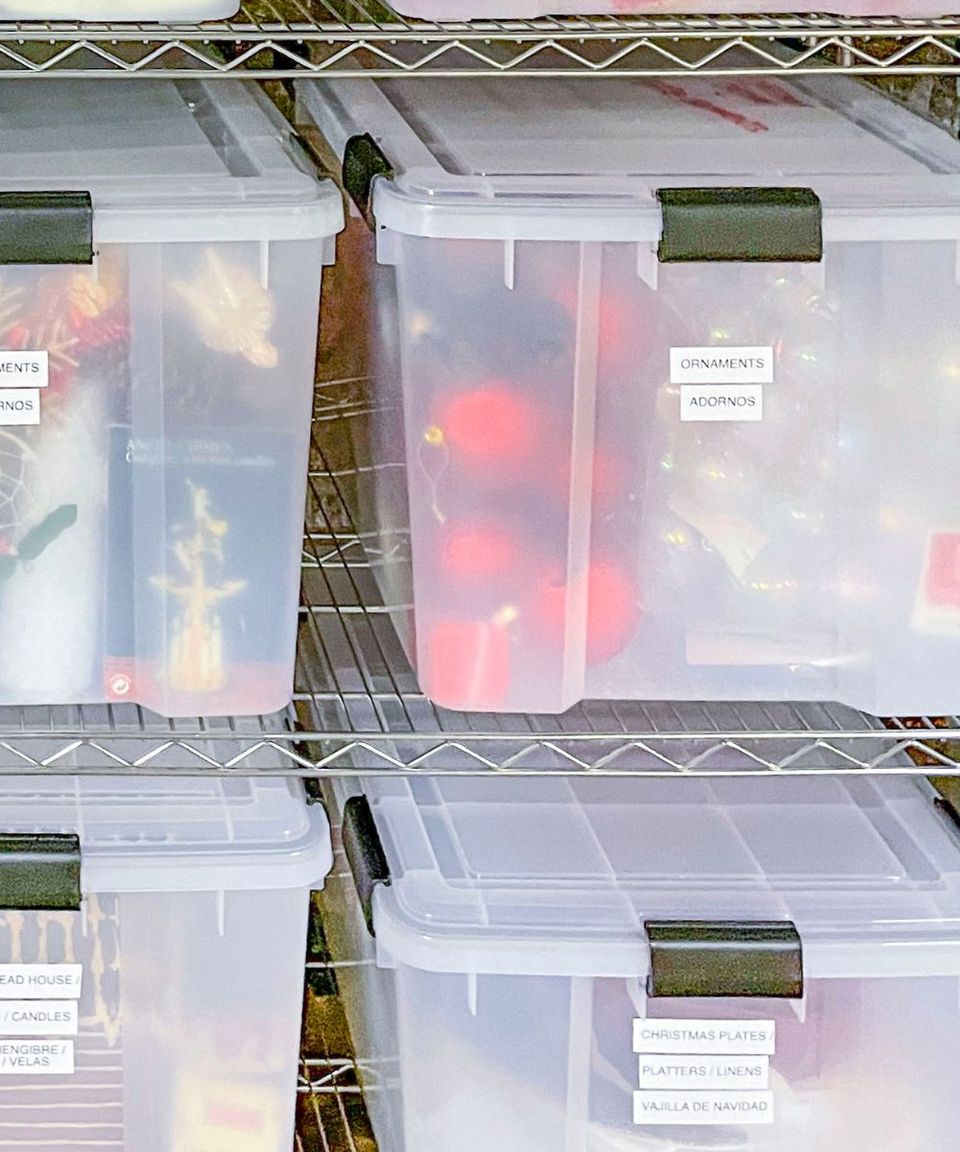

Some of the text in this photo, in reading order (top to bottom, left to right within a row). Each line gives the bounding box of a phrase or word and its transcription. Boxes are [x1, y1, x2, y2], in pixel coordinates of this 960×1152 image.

[681, 358, 764, 369] ORNAMENTS
[690, 396, 755, 407] ADORNOS
[28, 975, 73, 985] HOUSE
[12, 1012, 71, 1021] CANDLES
[641, 1029, 715, 1040] CHRISTMAS
[720, 1031, 766, 1041] PLATES
[10, 1057, 50, 1066] VELAS
[643, 1066, 706, 1076] PLATTERS
[717, 1066, 762, 1076] LINENS
[642, 1101, 767, 1112] VAJILLA DE NAVIDAD
